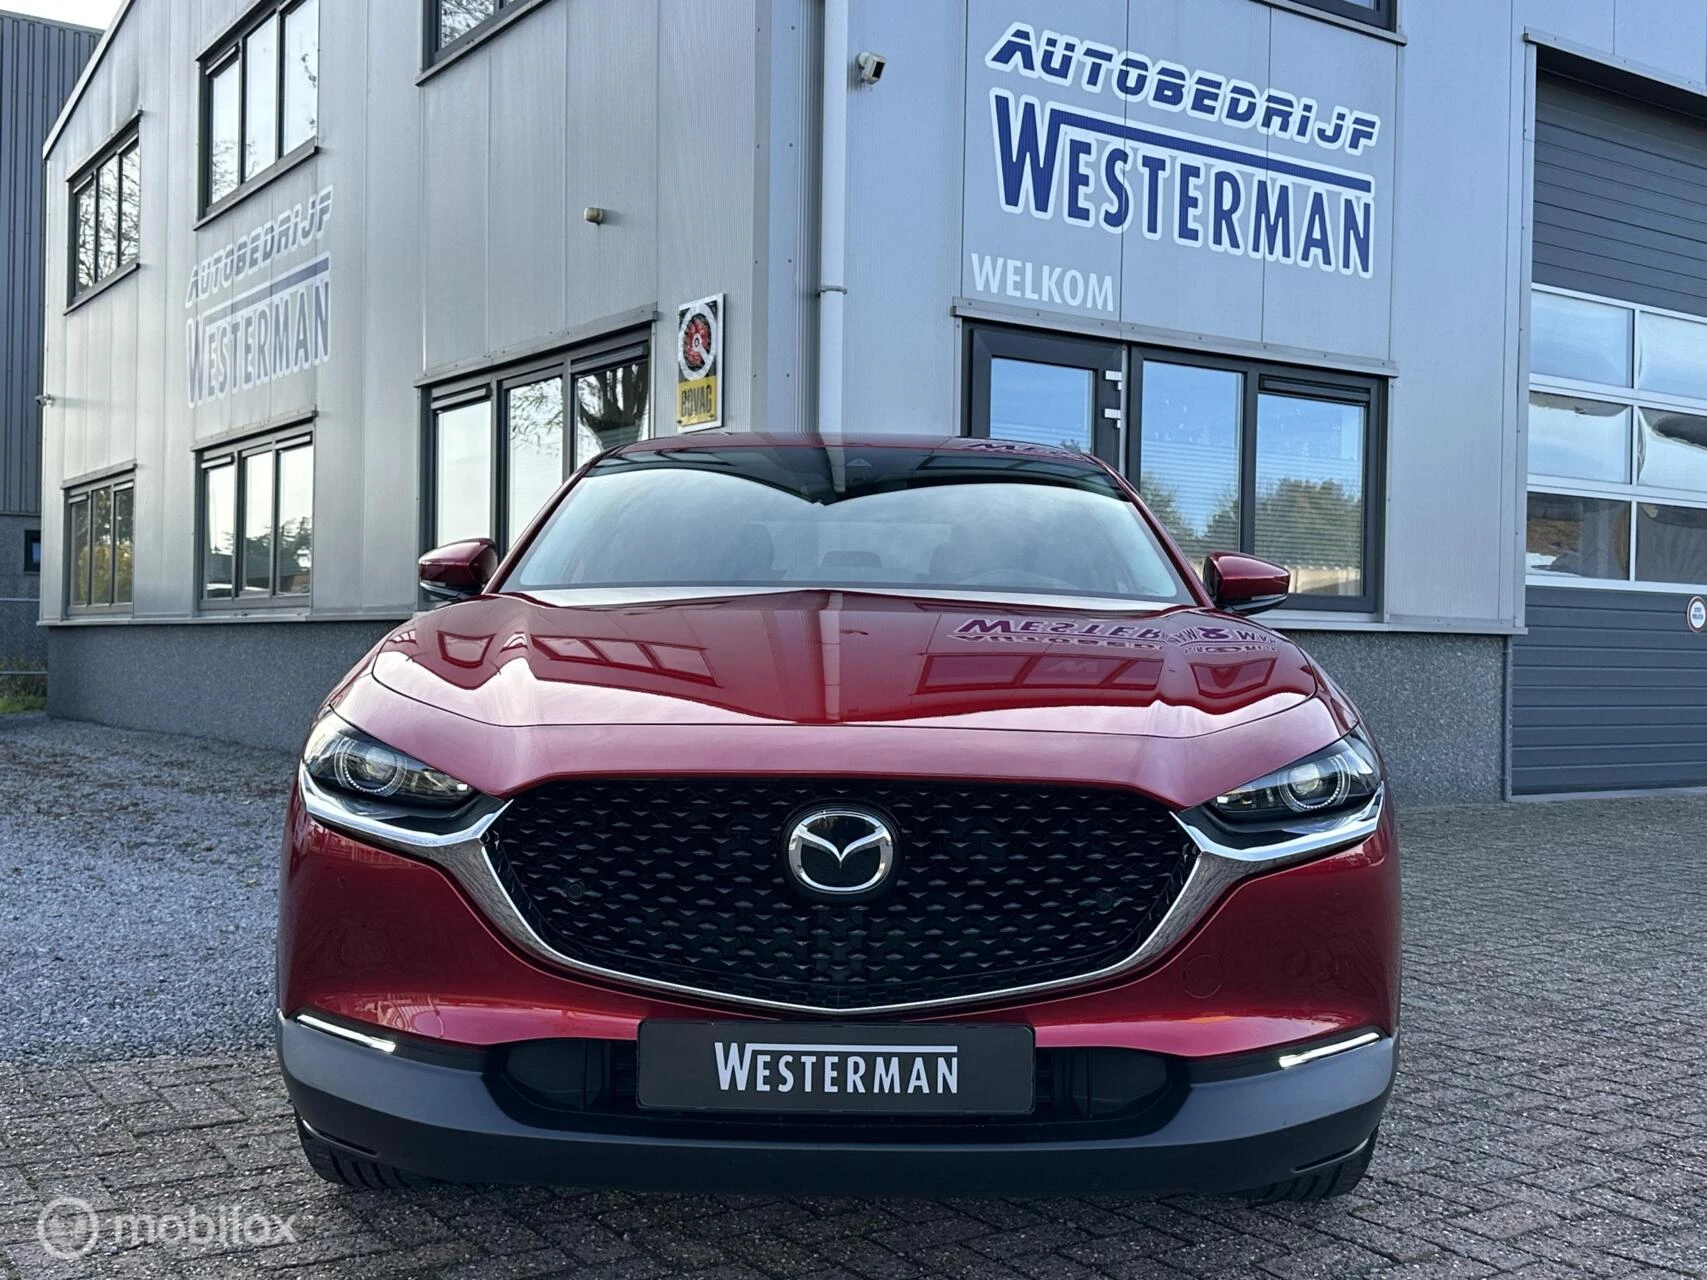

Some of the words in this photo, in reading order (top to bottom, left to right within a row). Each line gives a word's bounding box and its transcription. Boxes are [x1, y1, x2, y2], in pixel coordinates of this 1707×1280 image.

[988, 24, 1378, 153] AUTOBEDRIJF
[991, 90, 1374, 276] WESTERMAN
[186, 186, 333, 307] AUTOBEDRIJF
[971, 253, 1114, 311] WELKOM
[186, 253, 331, 406] WESTERMAN
[681, 384, 712, 417] BOVAG
[714, 1042, 958, 1093] WESTERMAN
